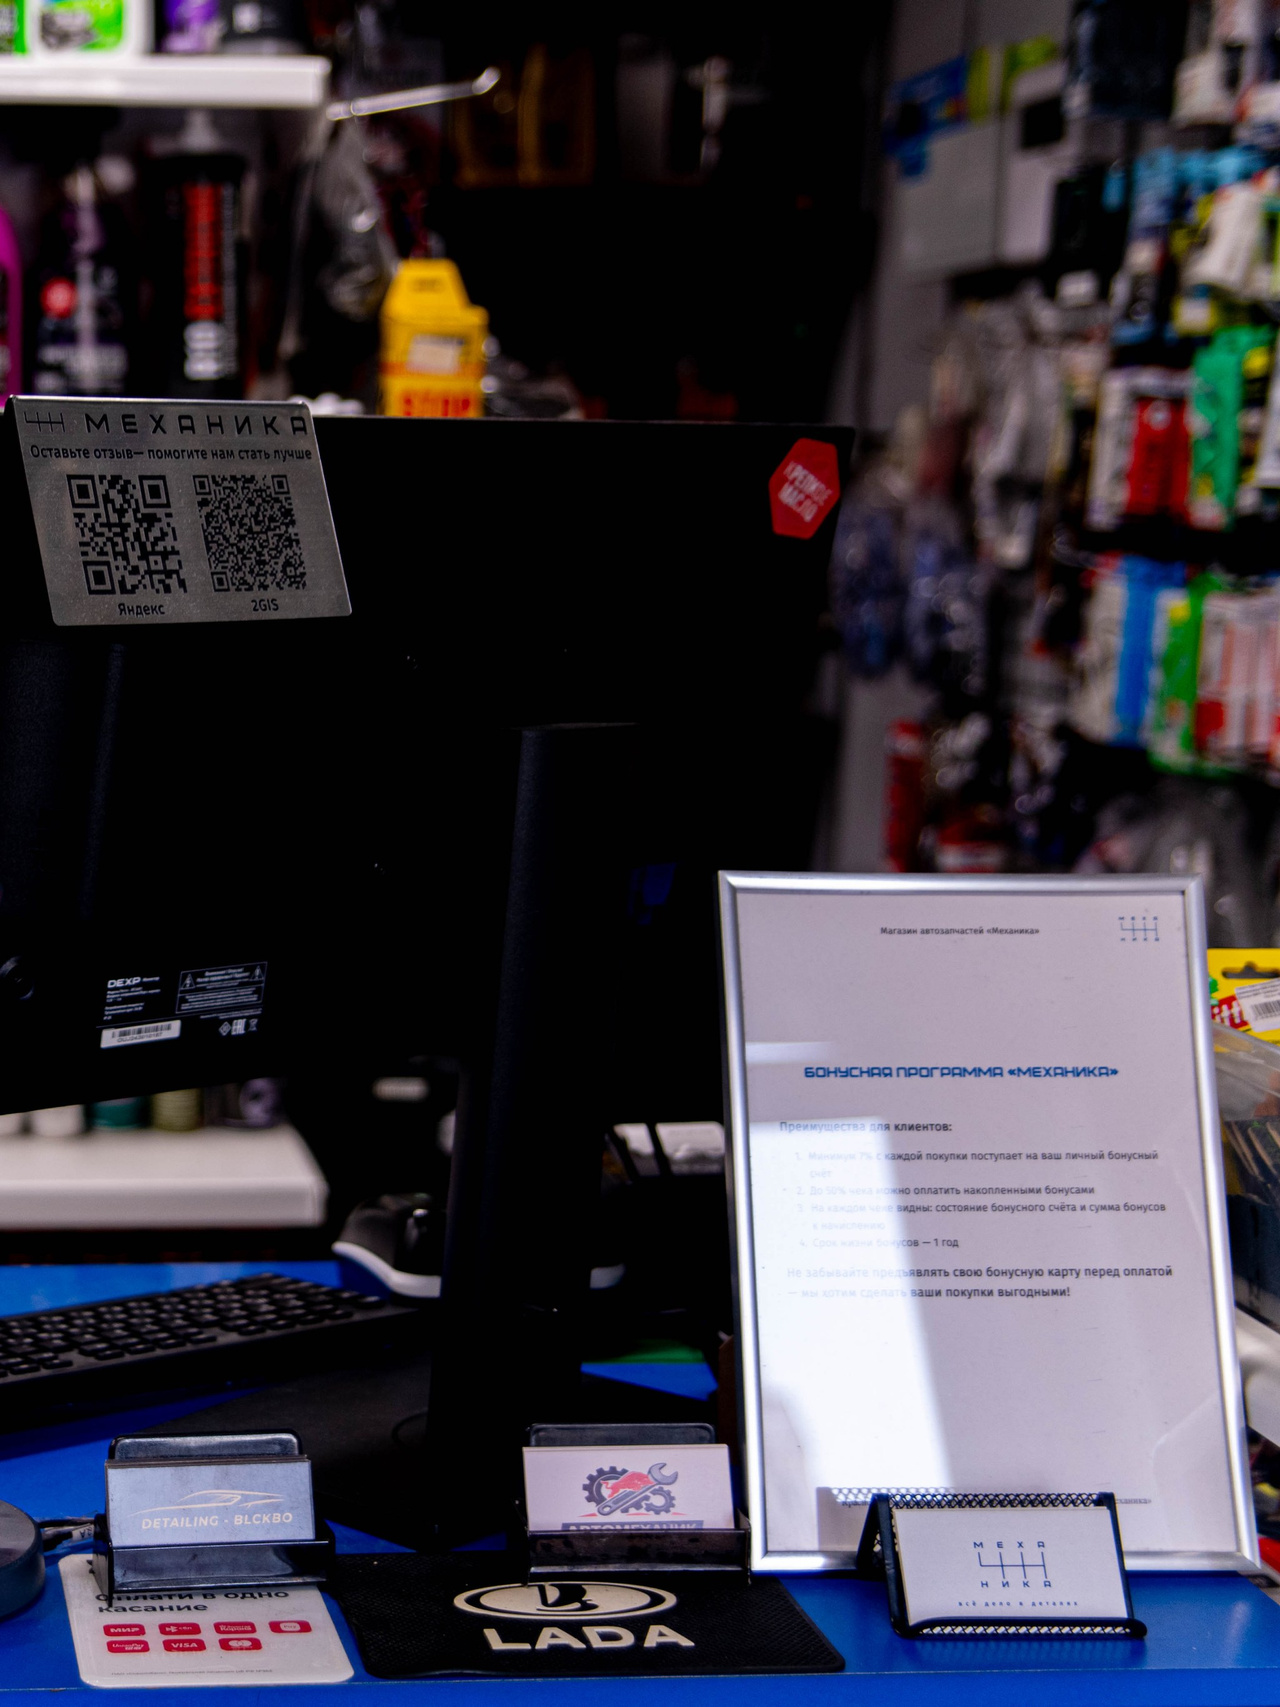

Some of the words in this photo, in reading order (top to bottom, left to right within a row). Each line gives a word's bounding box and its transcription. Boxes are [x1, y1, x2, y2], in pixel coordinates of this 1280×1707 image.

[84, 412, 308, 436] МЕХАНИКА
[30, 444, 90, 459] Оставьте
[147, 448, 207, 461] помогите
[211, 449, 235, 460] нам
[238, 450, 270, 460] стать
[273, 450, 312, 463] лучше
[119, 602, 166, 617] Яндекс
[251, 599, 279, 612] 2GIS
[880, 926, 918, 935] Магазин
[920, 926, 985, 935] автозапчастей
[986, 926, 1040, 935] «Механика»
[107, 976, 141, 988] DEXP
[804, 1066, 893, 1078] БОНУСНАЯ
[895, 1066, 1004, 1078] ПРОГРАММА
[1007, 1066, 1120, 1078] «МЕХАНИКА»
[780, 1121, 866, 1135] Преимущества
[870, 1122, 892, 1134] для
[894, 1122, 954, 1132] клиентов:
[884, 1150, 923, 1162] каждой
[926, 1152, 968, 1162] покупки
[970, 1152, 1023, 1162] поступает
[1026, 1152, 1038, 1161] на
[1041, 1152, 1062, 1160] ваш
[1065, 1149, 1105, 1160] личный
[1108, 1149, 1159, 1162] бонусный
[809, 1185, 824, 1197] До
[876, 1187, 911, 1196] можно
[913, 1187, 961, 1196] оплатить
[963, 1186, 1042, 1195] накопленными
[1044, 1185, 1095, 1197] бонусами
[897, 1203, 933, 1213] видны:
[935, 1203, 988, 1212] состояние
[991, 1202, 1046, 1214] бонусного
[1048, 1202, 1077, 1212] счёта
[1079, 1203, 1087, 1212] и
[1089, 1203, 1121, 1214] сумма
[1123, 1202, 1166, 1213] бонусов
[941, 1239, 959, 1250] год
[787, 1267, 802, 1278] Не
[805, 1266, 869, 1278] забывайте
[872, 1268, 949, 1279] предъявлять
[952, 1268, 983, 1277] свою
[986, 1266, 1044, 1279] бонусную
[1047, 1268, 1081, 1279] карту
[1084, 1268, 1120, 1280] перед
[1123, 1265, 1173, 1277] оплатой
[801, 1288, 818, 1297] мы
[910, 1288, 942, 1298] ваши
[945, 1288, 994, 1300] покупки
[998, 1286, 1071, 1299] выгодными!
[141, 1515, 219, 1530] DETAILING
[233, 1512, 293, 1526] BLCKBO
[224, 1591, 290, 1600] одно
[98, 1604, 209, 1614] касание
[483, 1624, 696, 1651] LADA
